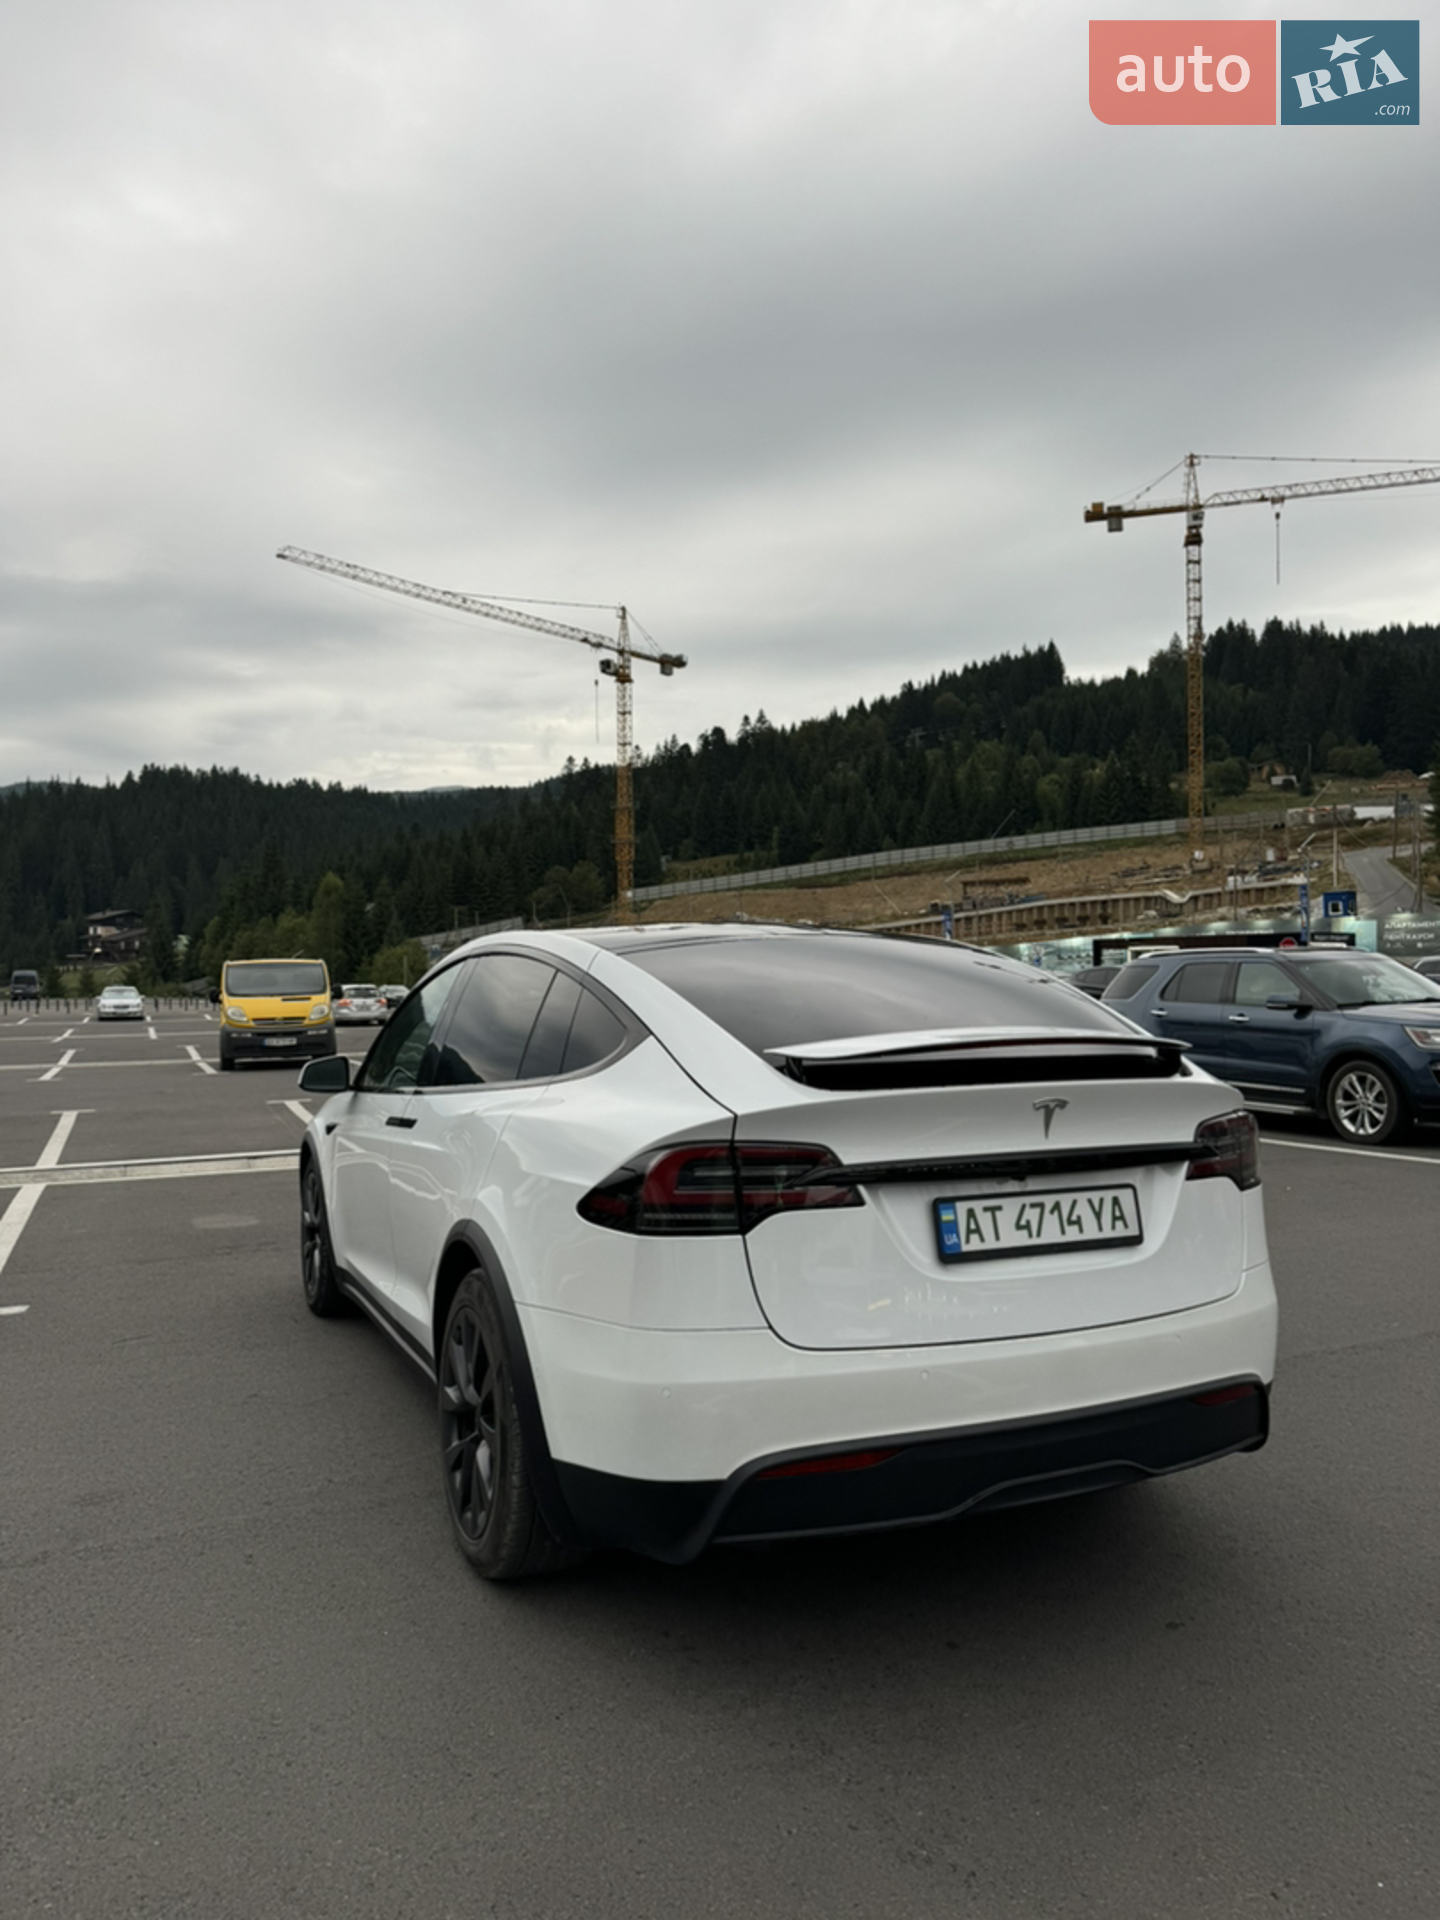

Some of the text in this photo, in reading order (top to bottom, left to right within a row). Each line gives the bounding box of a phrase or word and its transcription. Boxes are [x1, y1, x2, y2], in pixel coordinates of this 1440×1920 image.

[964, 1196, 1129, 1244] AT 4714 YA
[944, 1233, 959, 1245] UA
